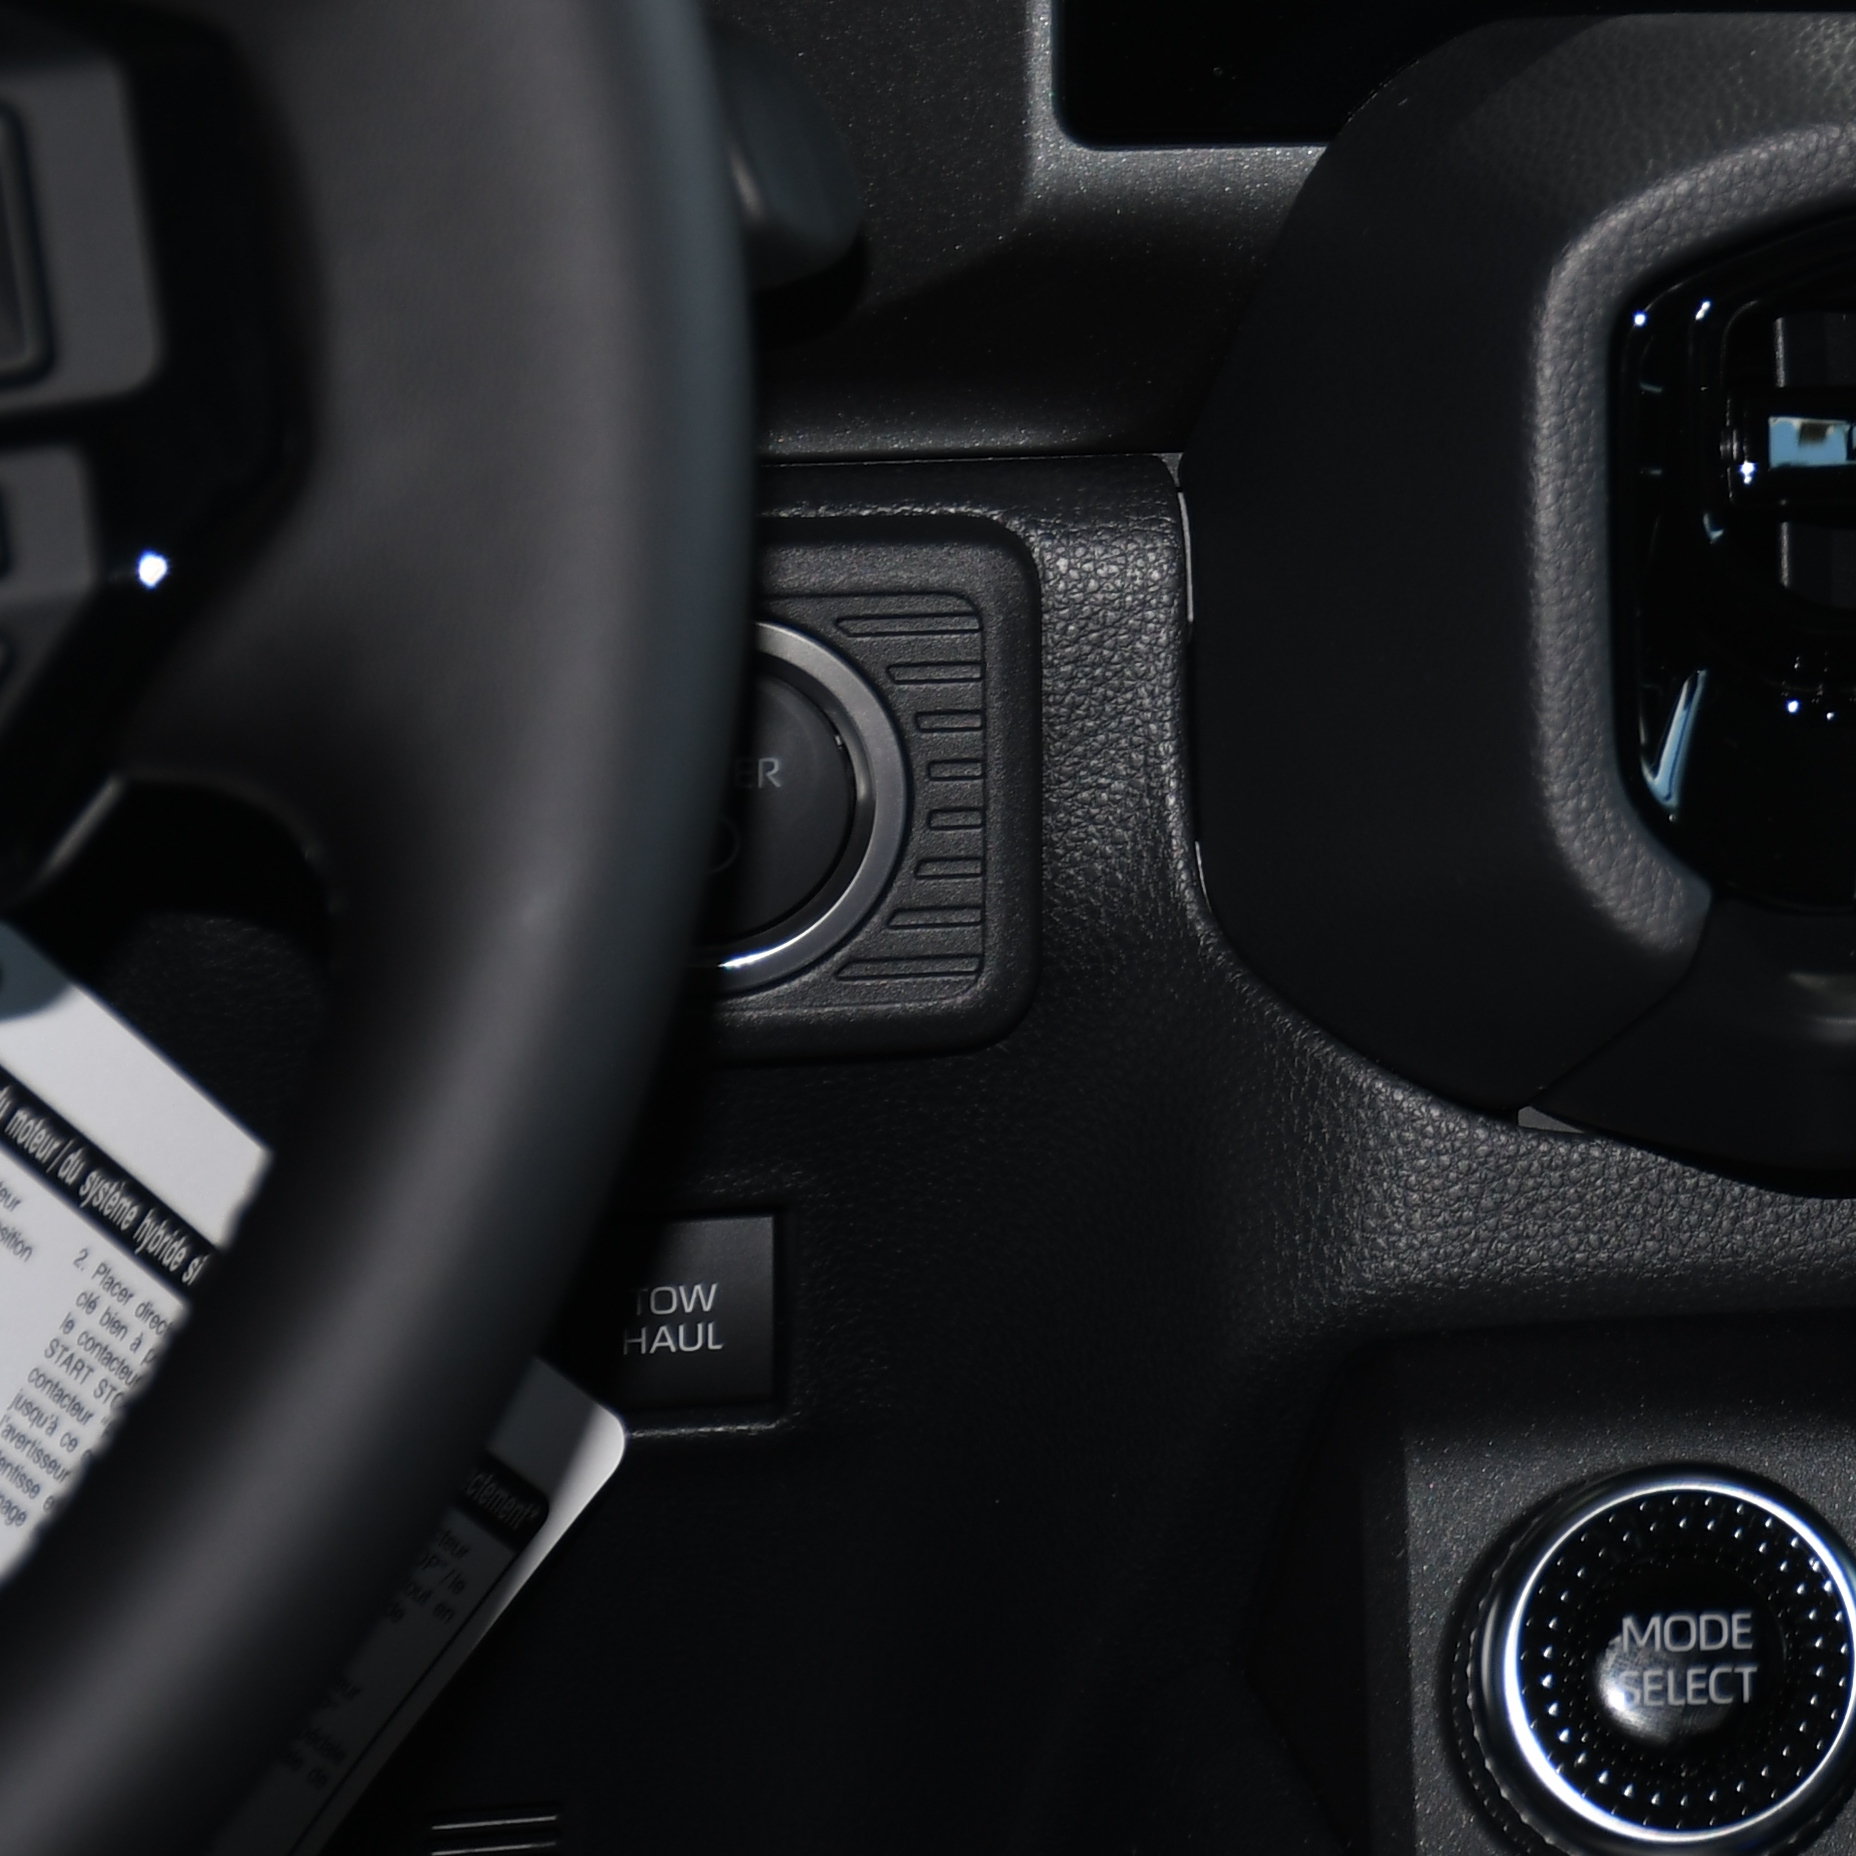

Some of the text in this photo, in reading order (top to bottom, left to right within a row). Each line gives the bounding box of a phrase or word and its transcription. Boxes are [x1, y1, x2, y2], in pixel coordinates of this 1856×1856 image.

[76, 1169, 140, 1231] système
[132, 1206, 188, 1273] hybride
[91, 1262, 133, 1306] Placer
[628, 1282, 720, 1316] TOW
[98, 1305, 128, 1341] bien
[622, 1325, 725, 1357] HAUL
[43, 1336, 94, 1385] START
[26, 1366, 93, 1425] contacteur
[1621, 1611, 1753, 1652] MODE
[1620, 1667, 1758, 1706] SELECT
